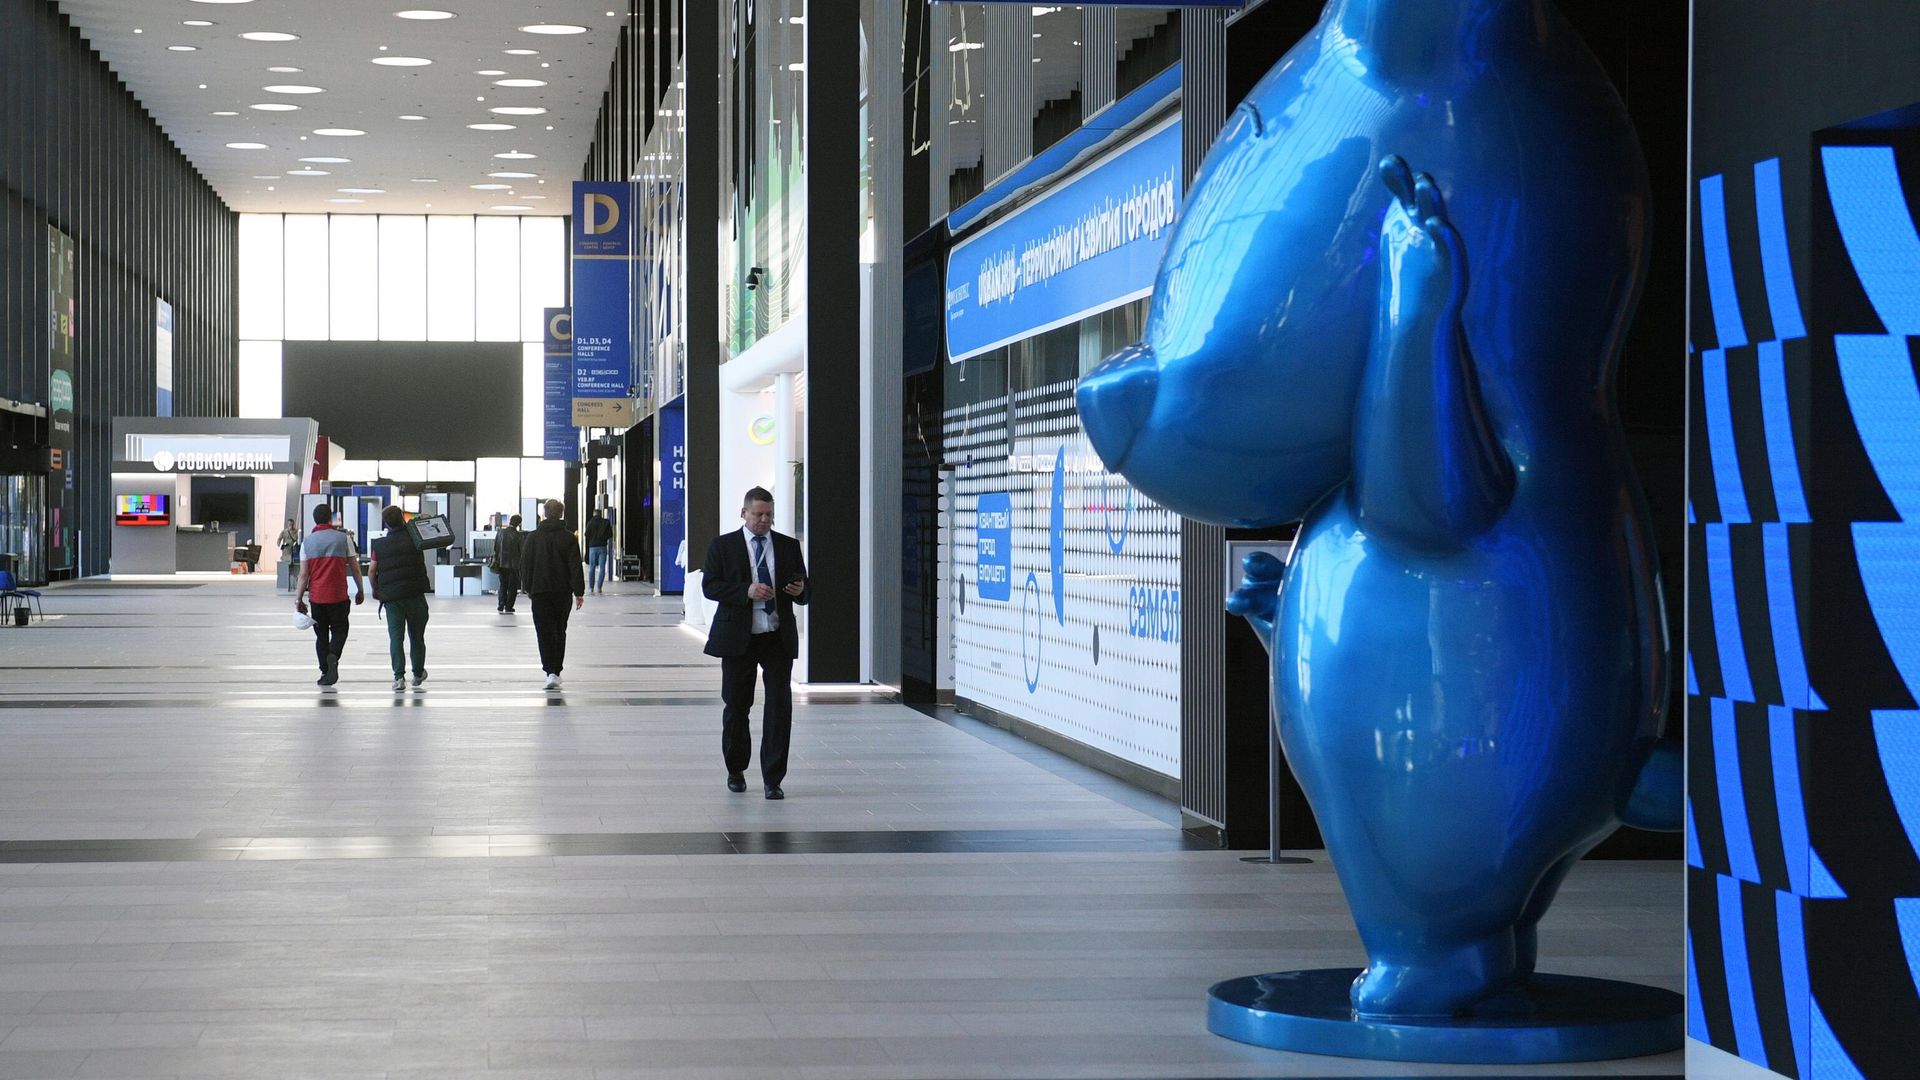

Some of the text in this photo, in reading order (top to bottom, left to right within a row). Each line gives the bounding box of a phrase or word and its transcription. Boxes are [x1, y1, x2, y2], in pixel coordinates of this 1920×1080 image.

[584, 193, 620, 234] D
[1022, 230, 1072, 288] ТЕРРИТОРИЯ
[1073, 205, 1120, 265] РАЗВИТИЯ
[1122, 178, 1174, 243] ГОРОДОВ
[549, 313, 571, 340] C
[577, 337, 612, 346] D1, D3, D4
[577, 368, 587, 376] D2
[177, 452, 274, 471] СОВКОМБАНК
[978, 538, 997, 558] ГОРОД
[978, 564, 1006, 583] БУДУЩЕГО
